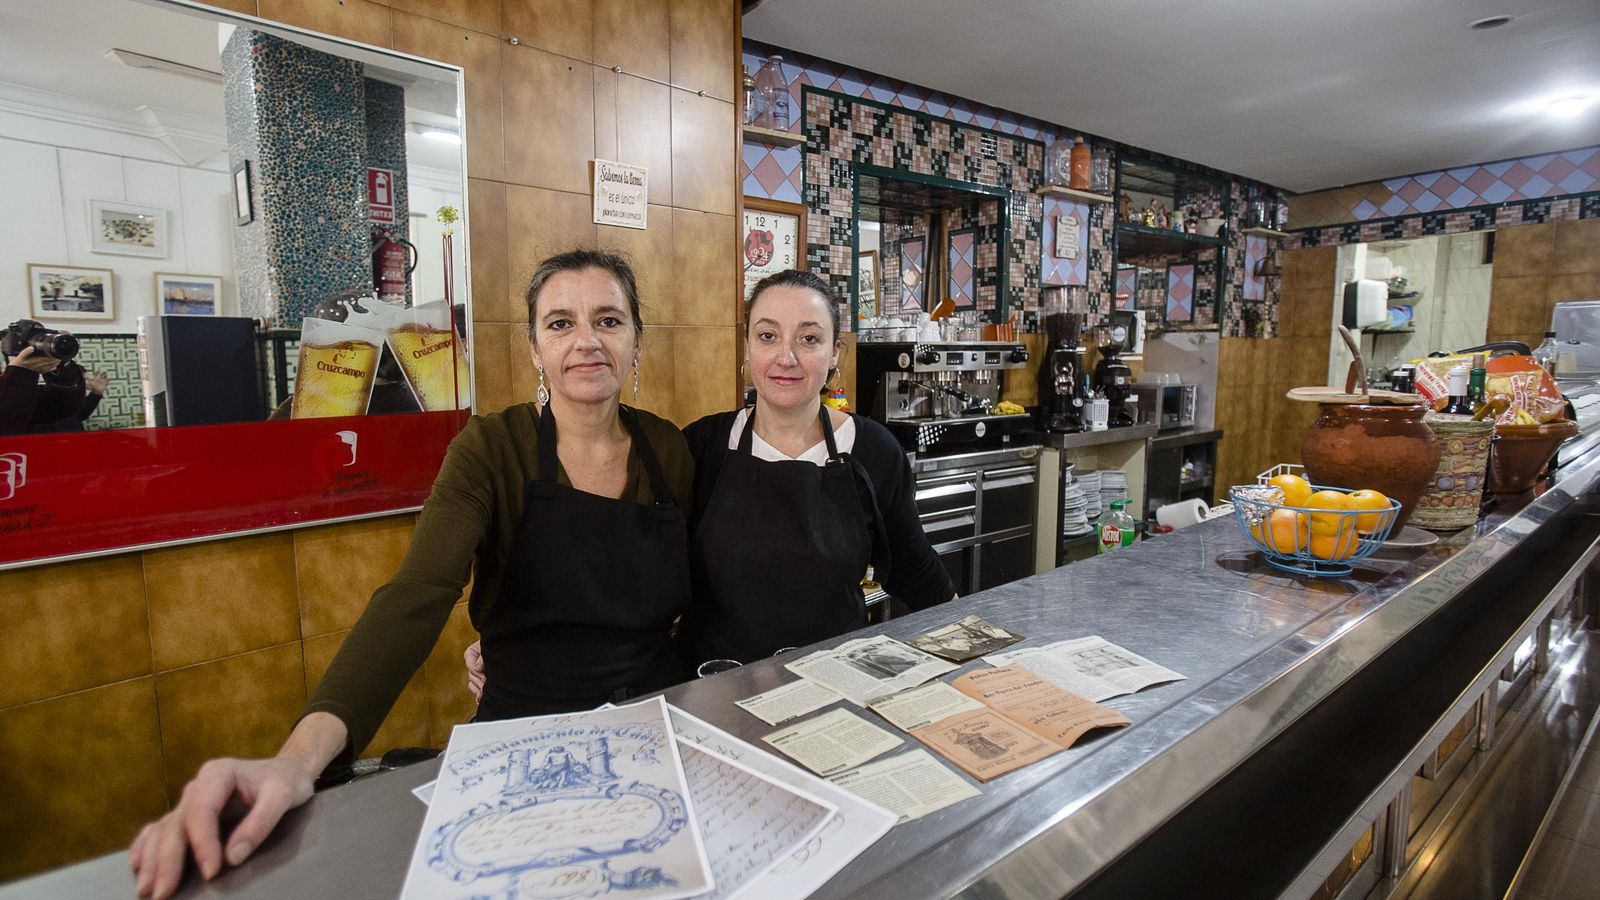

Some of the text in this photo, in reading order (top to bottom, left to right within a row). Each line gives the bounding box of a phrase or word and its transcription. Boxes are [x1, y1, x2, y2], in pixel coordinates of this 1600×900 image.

[600, 164, 623, 184] Salvemos
[624, 171, 629, 185] la
[608, 193, 615, 203] es
[755, 216, 766, 227] 12
[774, 219, 778, 229] 1
[784, 234, 791, 245] 2
[784, 254, 790, 265] 3
[413, 339, 452, 360] Cruzcampo
[317, 361, 366, 379] Cruzcampo
